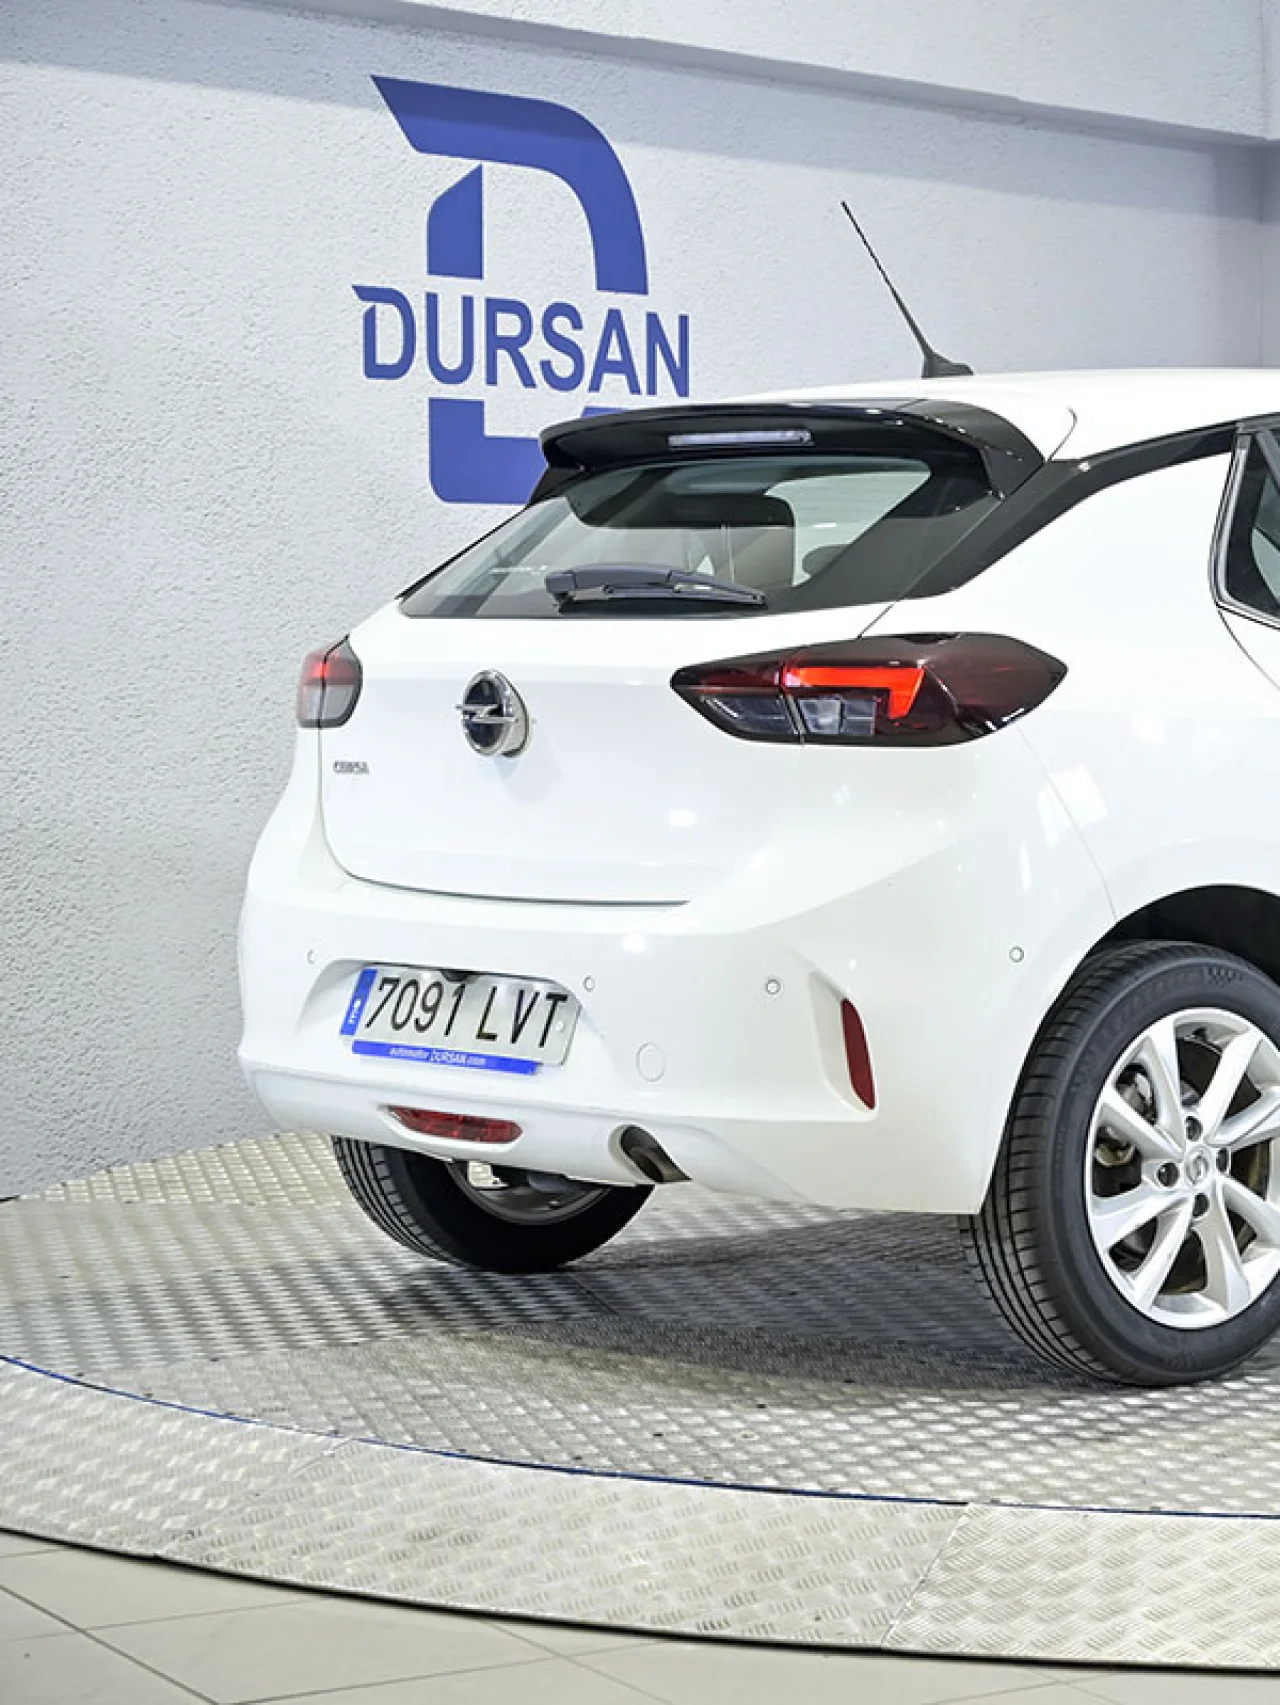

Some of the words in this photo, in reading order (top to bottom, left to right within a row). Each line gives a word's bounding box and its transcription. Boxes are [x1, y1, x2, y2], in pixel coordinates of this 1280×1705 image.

[352, 283, 690, 398] DURSAN
[365, 976, 466, 1037] 7091
[475, 985, 568, 1048] LVT
